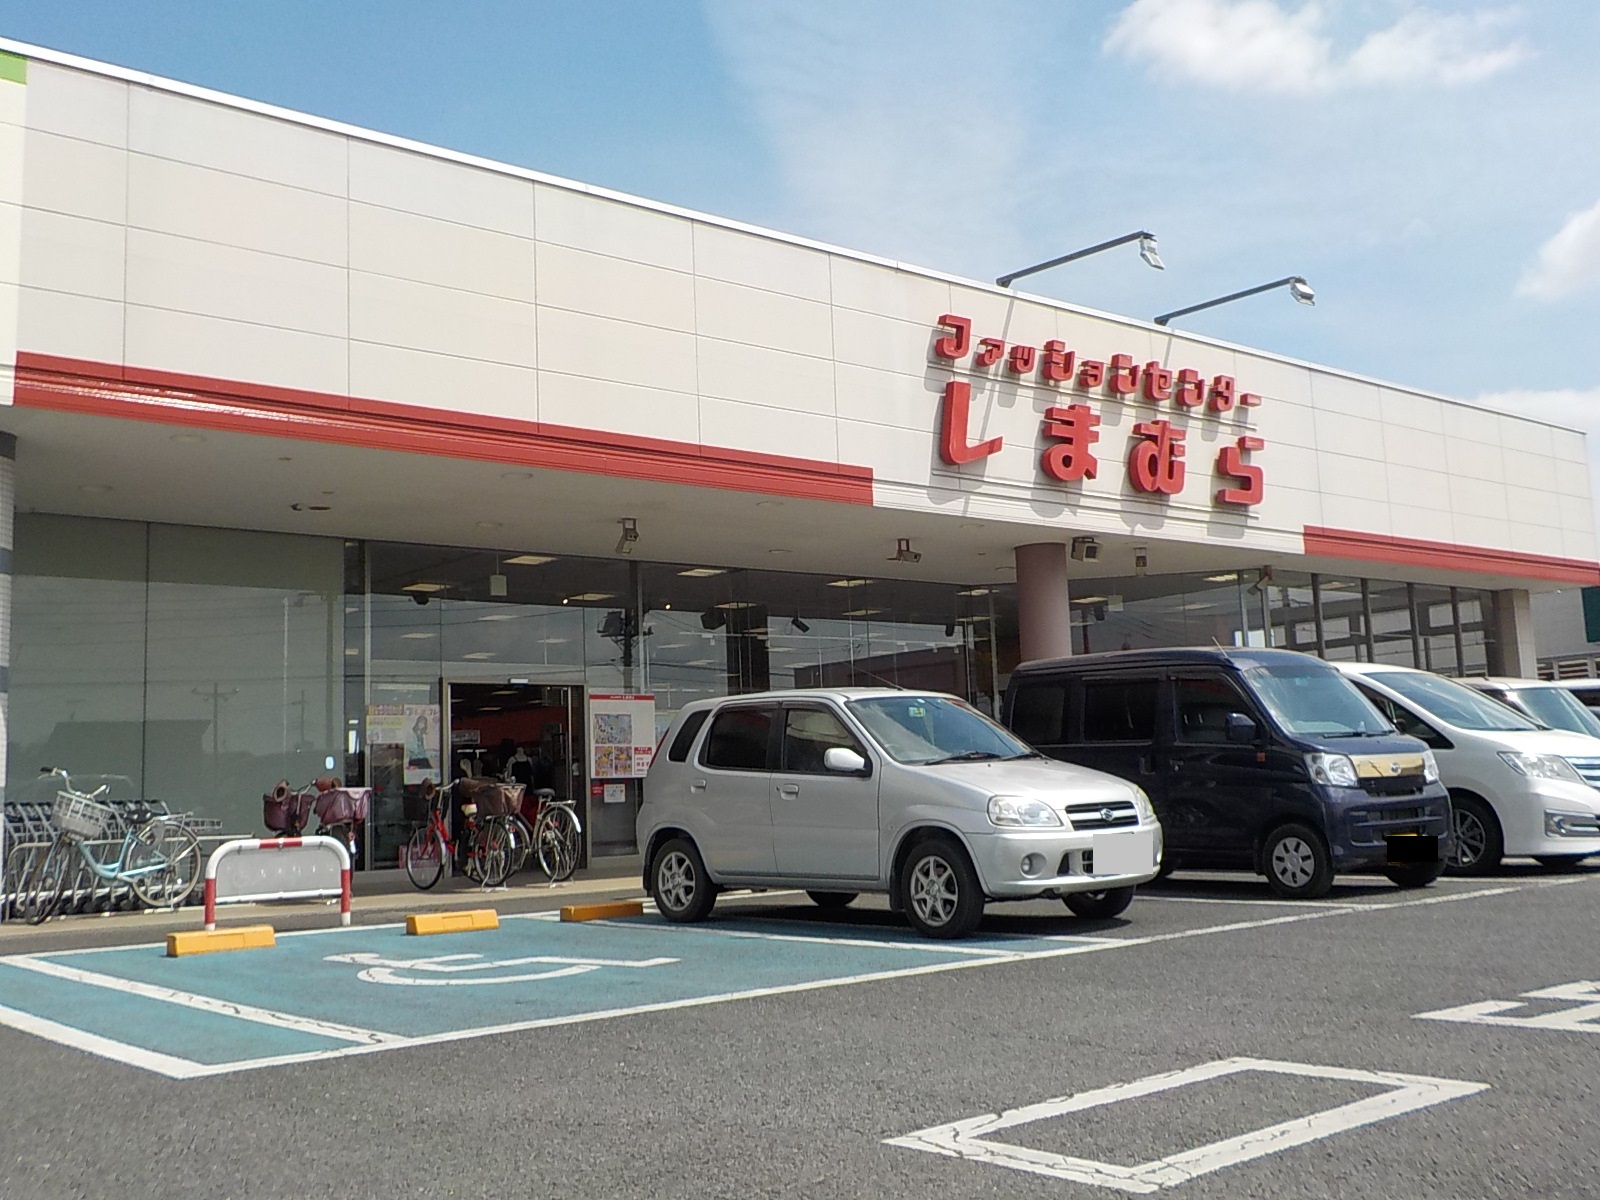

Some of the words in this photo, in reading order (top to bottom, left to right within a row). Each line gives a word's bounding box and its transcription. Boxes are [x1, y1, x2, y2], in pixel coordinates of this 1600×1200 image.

[936, 314, 1262, 412] ファッションセンター
[940, 380, 1265, 506] しまむら
